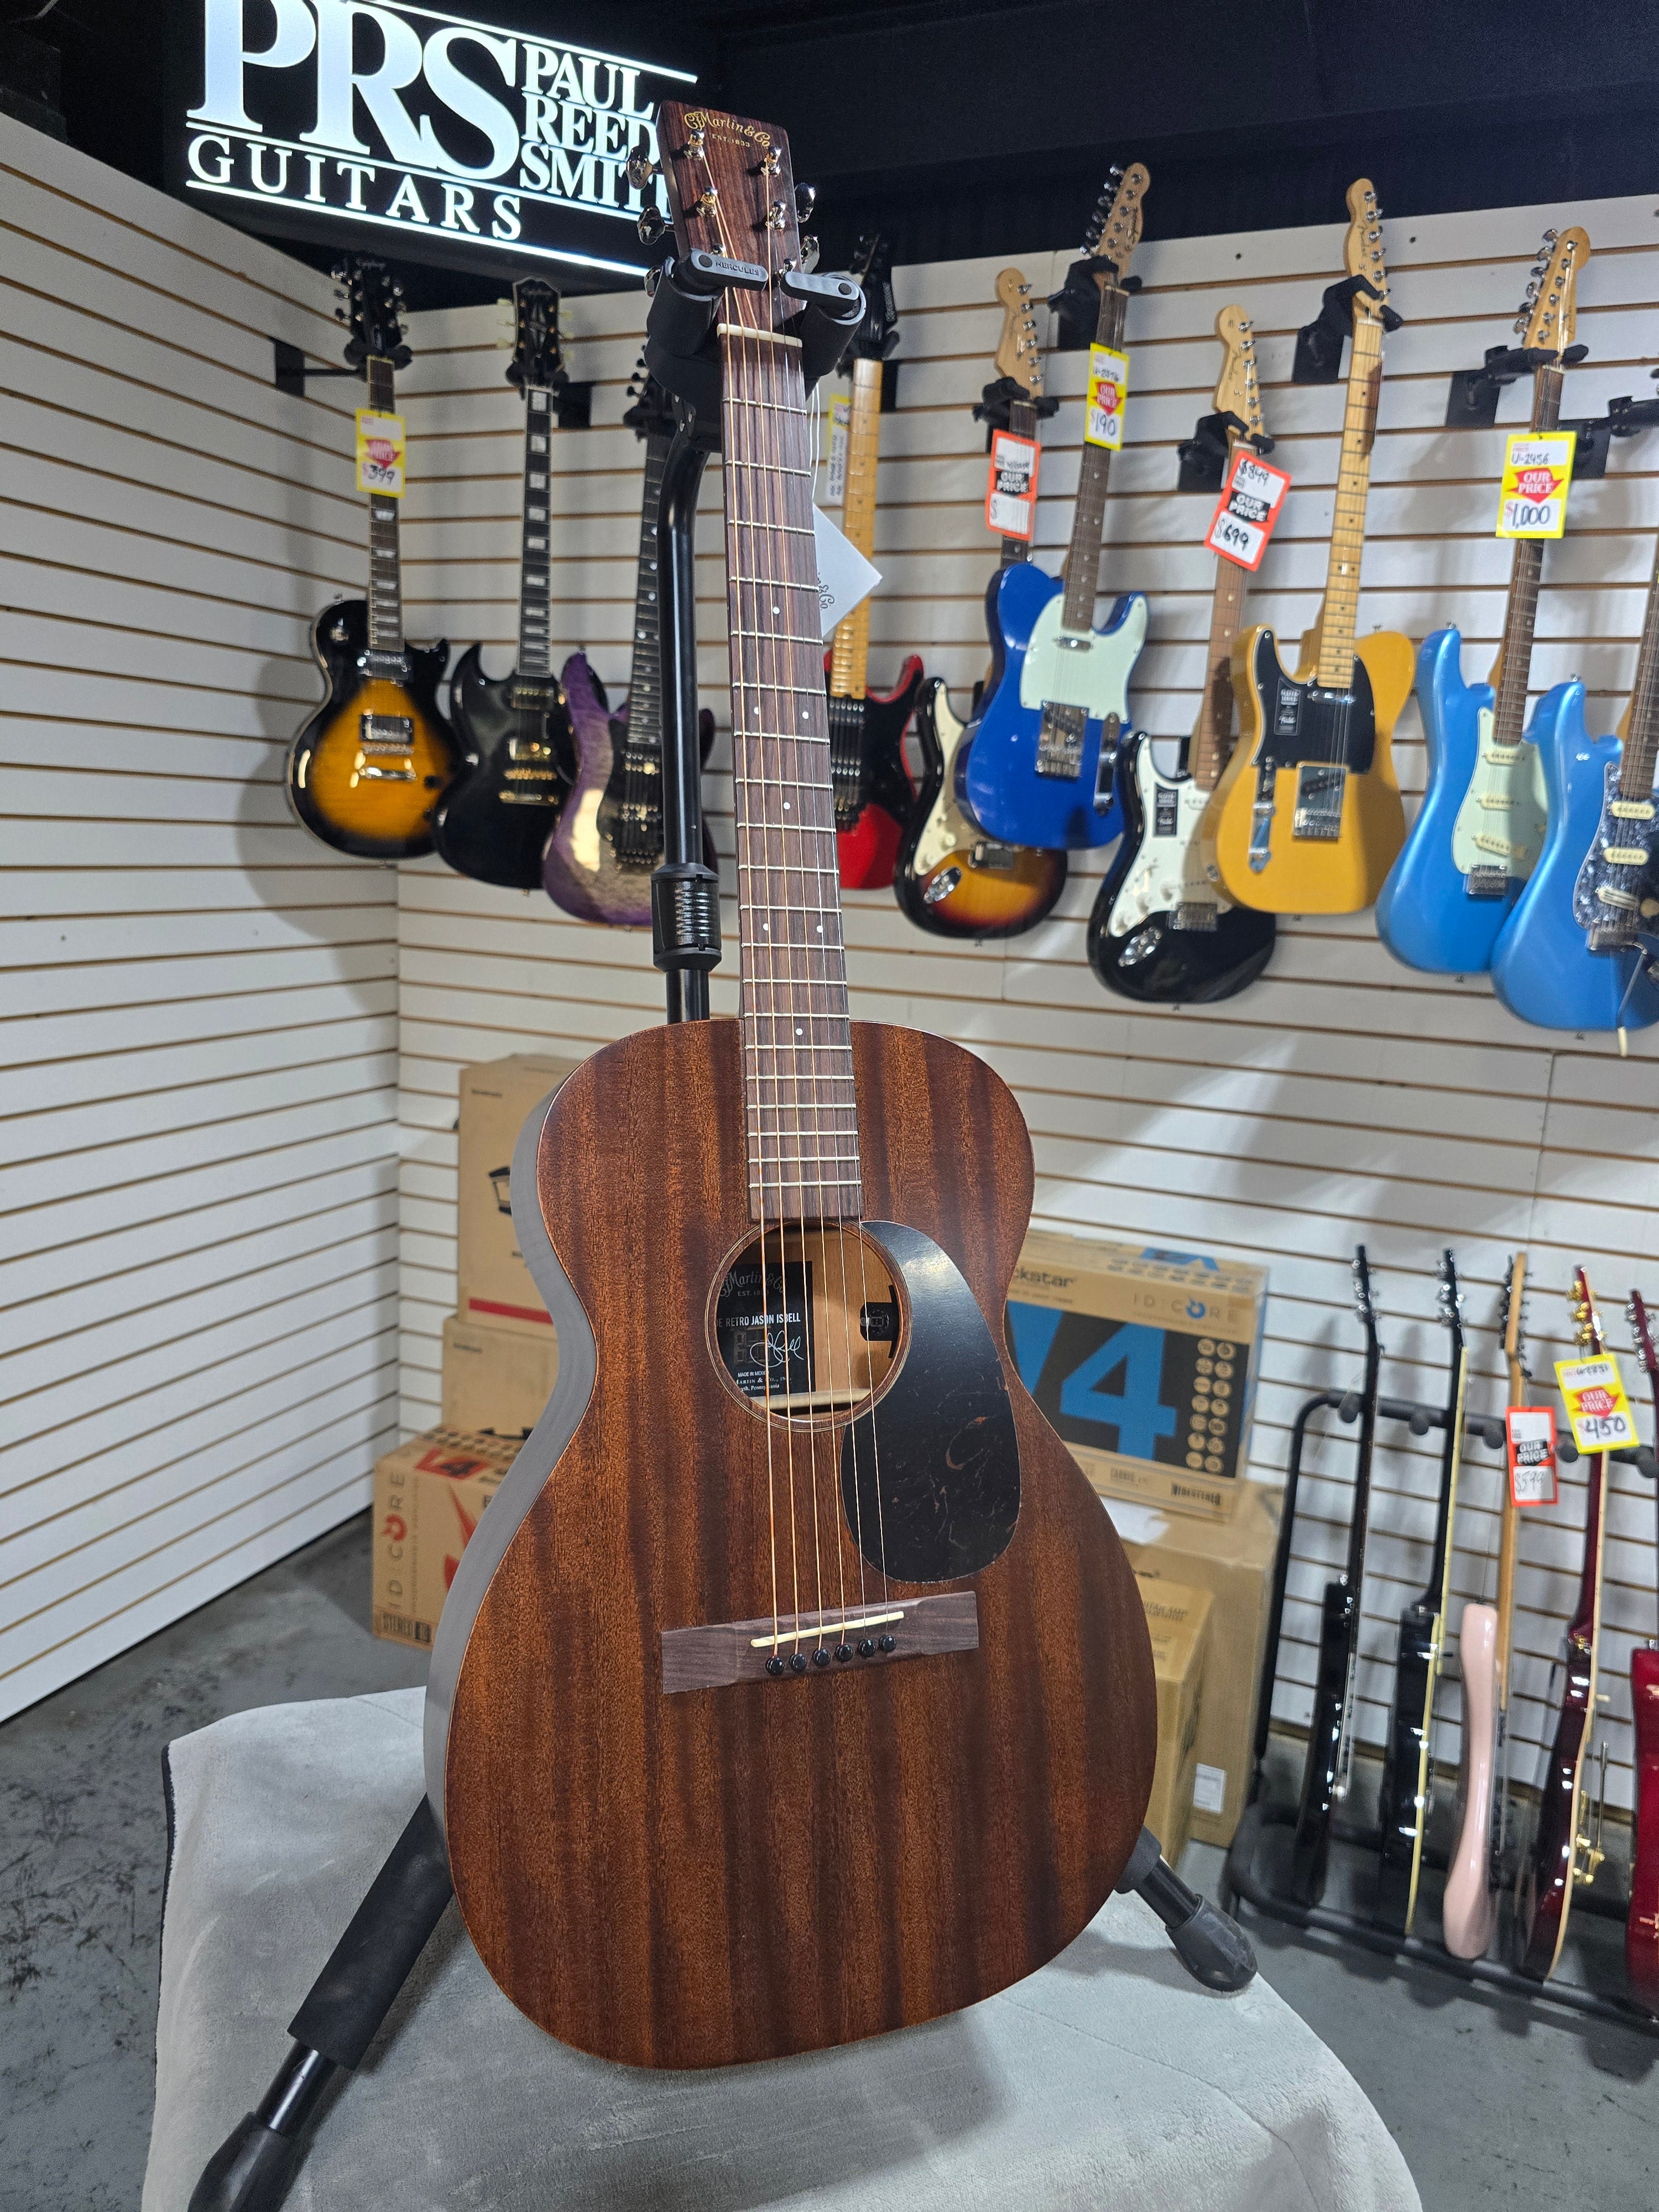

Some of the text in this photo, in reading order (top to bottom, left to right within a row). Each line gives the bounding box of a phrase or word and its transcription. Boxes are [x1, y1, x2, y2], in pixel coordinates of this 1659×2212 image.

[521, 43, 654, 121] PAUL
[187, 0, 518, 180] PRS
[521, 92, 661, 166] REED
[187, 134, 521, 241] GUITARS
[716, 260, 760, 276] HERCULES
[1100, 384, 1116, 398] OUR
[1097, 394, 1118, 409] PRICE
[1000, 471, 1025, 482] OUR
[1523, 471, 1551, 483] OUR
[997, 480, 1029, 493] PRICE
[1518, 482, 1555, 494] PRICE
[1236, 492, 1265, 510] OUR
[1228, 500, 1268, 522] PRICE
[1015, 1265, 1077, 1289] ckstar
[726, 1316, 749, 1327] RETRO
[776, 1312, 801, 1324] ISBELL
[1582, 1389, 1607, 1402] OUR
[1580, 1397, 1614, 1412] PRICE
[1519, 1440, 1543, 1453] OUR
[1517, 1448, 1548, 1464] PRICE
